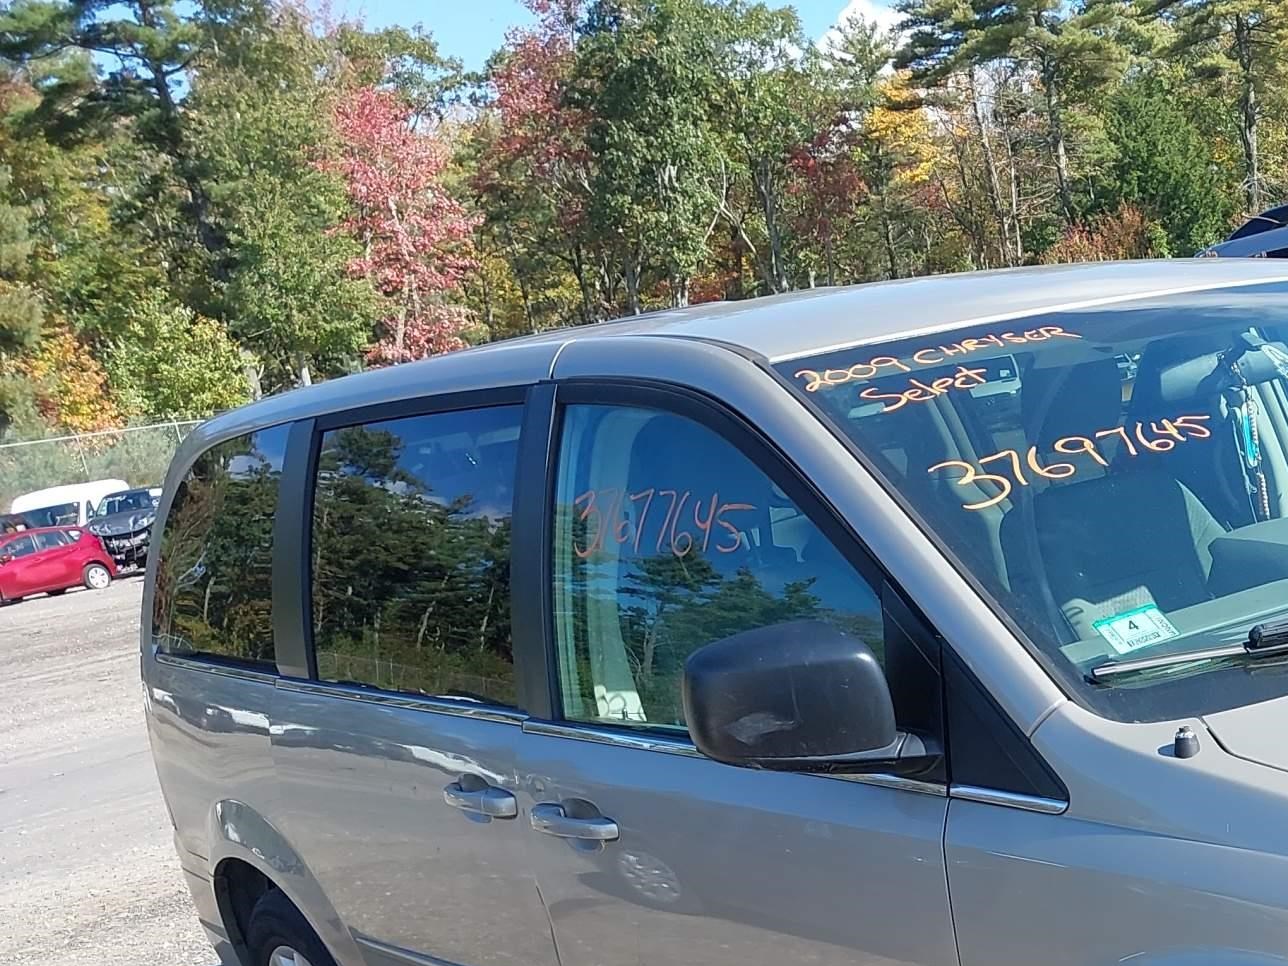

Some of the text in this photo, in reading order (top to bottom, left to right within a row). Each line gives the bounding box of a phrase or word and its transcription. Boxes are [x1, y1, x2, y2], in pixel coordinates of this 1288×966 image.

[794, 356, 911, 393] 2009
[927, 414, 1212, 511] 37697645
[1128, 620, 1140, 630] 4
